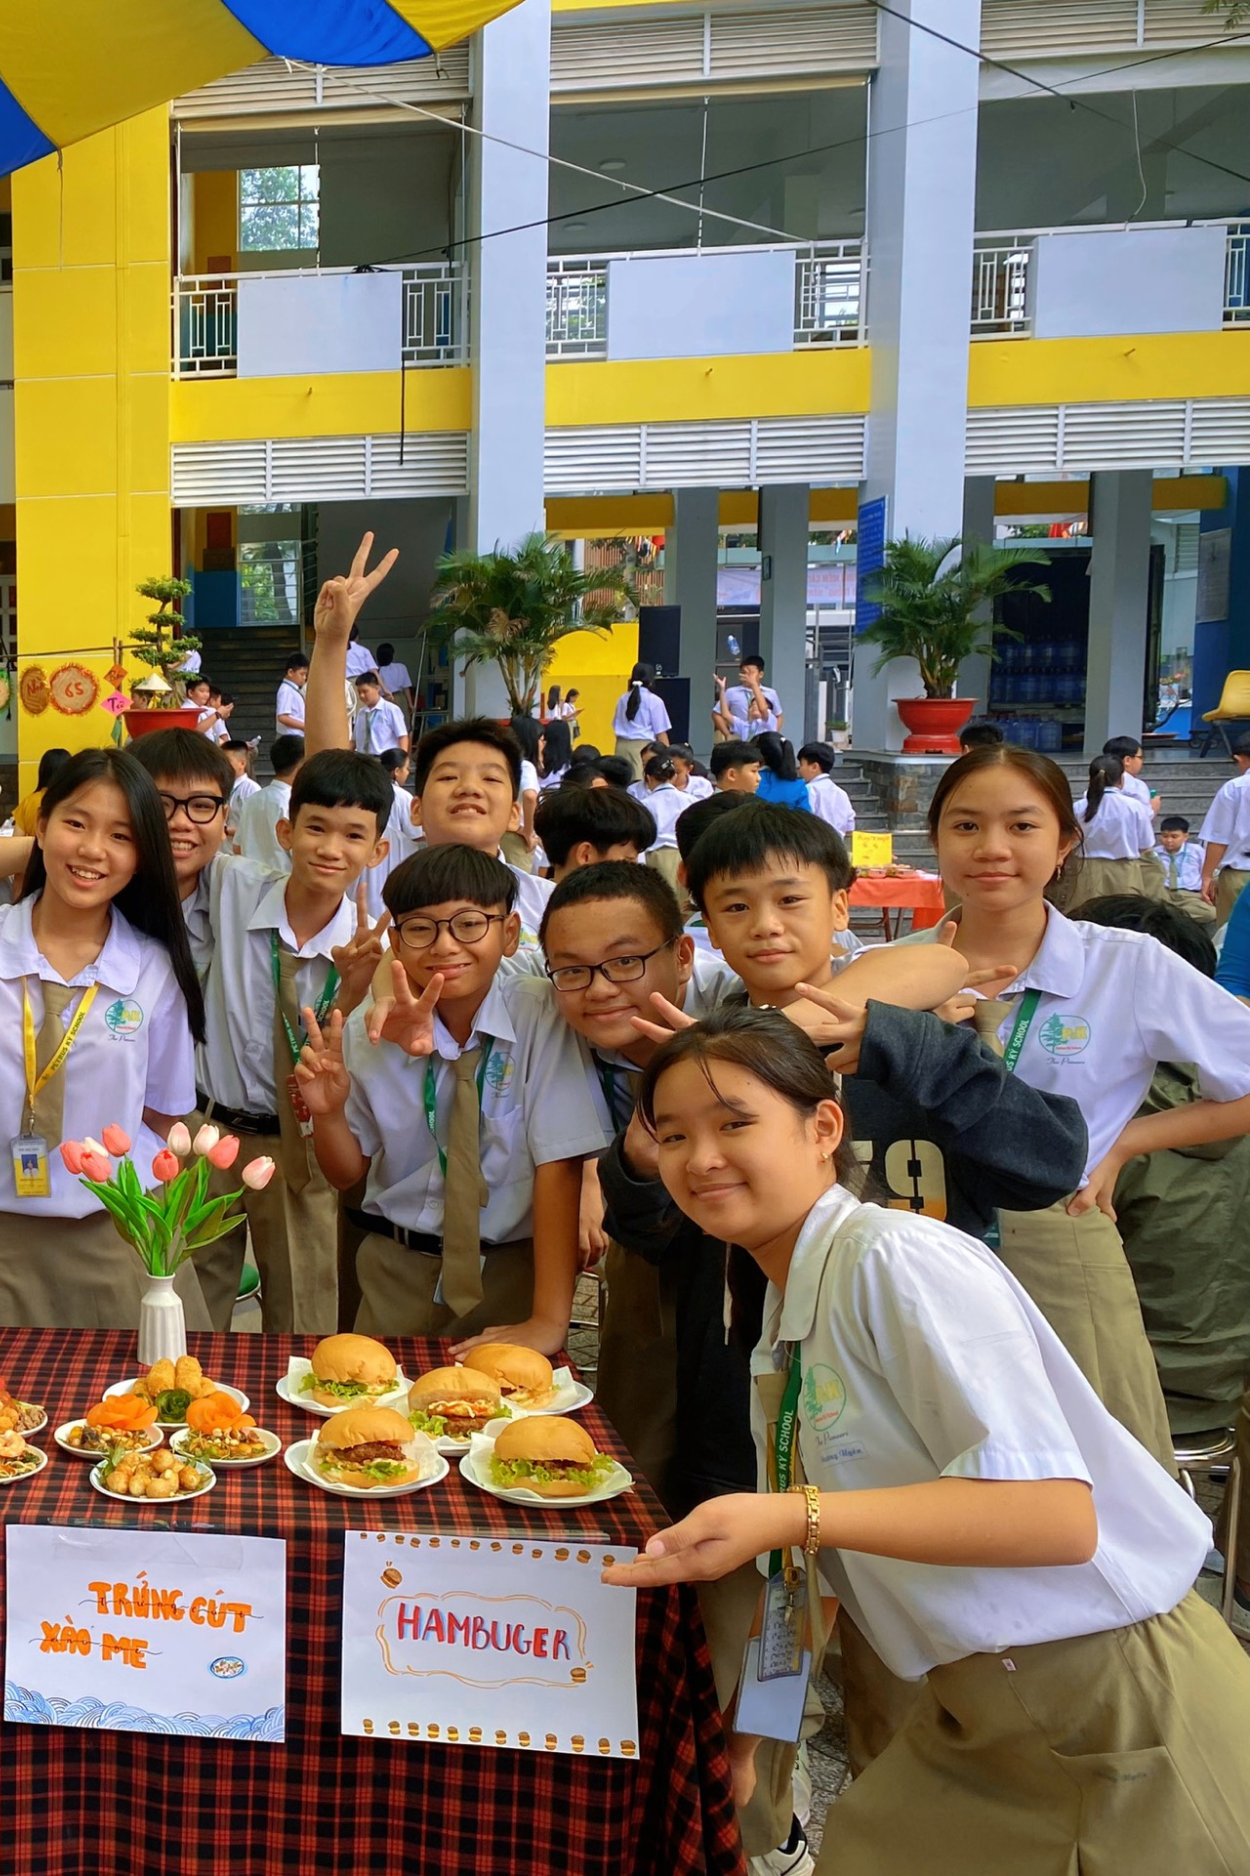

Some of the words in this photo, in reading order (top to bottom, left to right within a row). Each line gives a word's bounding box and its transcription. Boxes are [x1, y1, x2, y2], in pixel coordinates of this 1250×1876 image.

[71, 1012, 85, 1036] SCHOOL
[1013, 1019, 1029, 1047] SCHOOL
[779, 1410, 794, 1452] SCHOOL
[776, 1455, 787, 1470] KÝ
[88, 1570, 185, 1621] TRỨNG
[189, 1589, 252, 1633] CÚT
[39, 1614, 92, 1656] XÀO
[102, 1633, 148, 1669] ME
[397, 1602, 571, 1660] HAMBUGER
